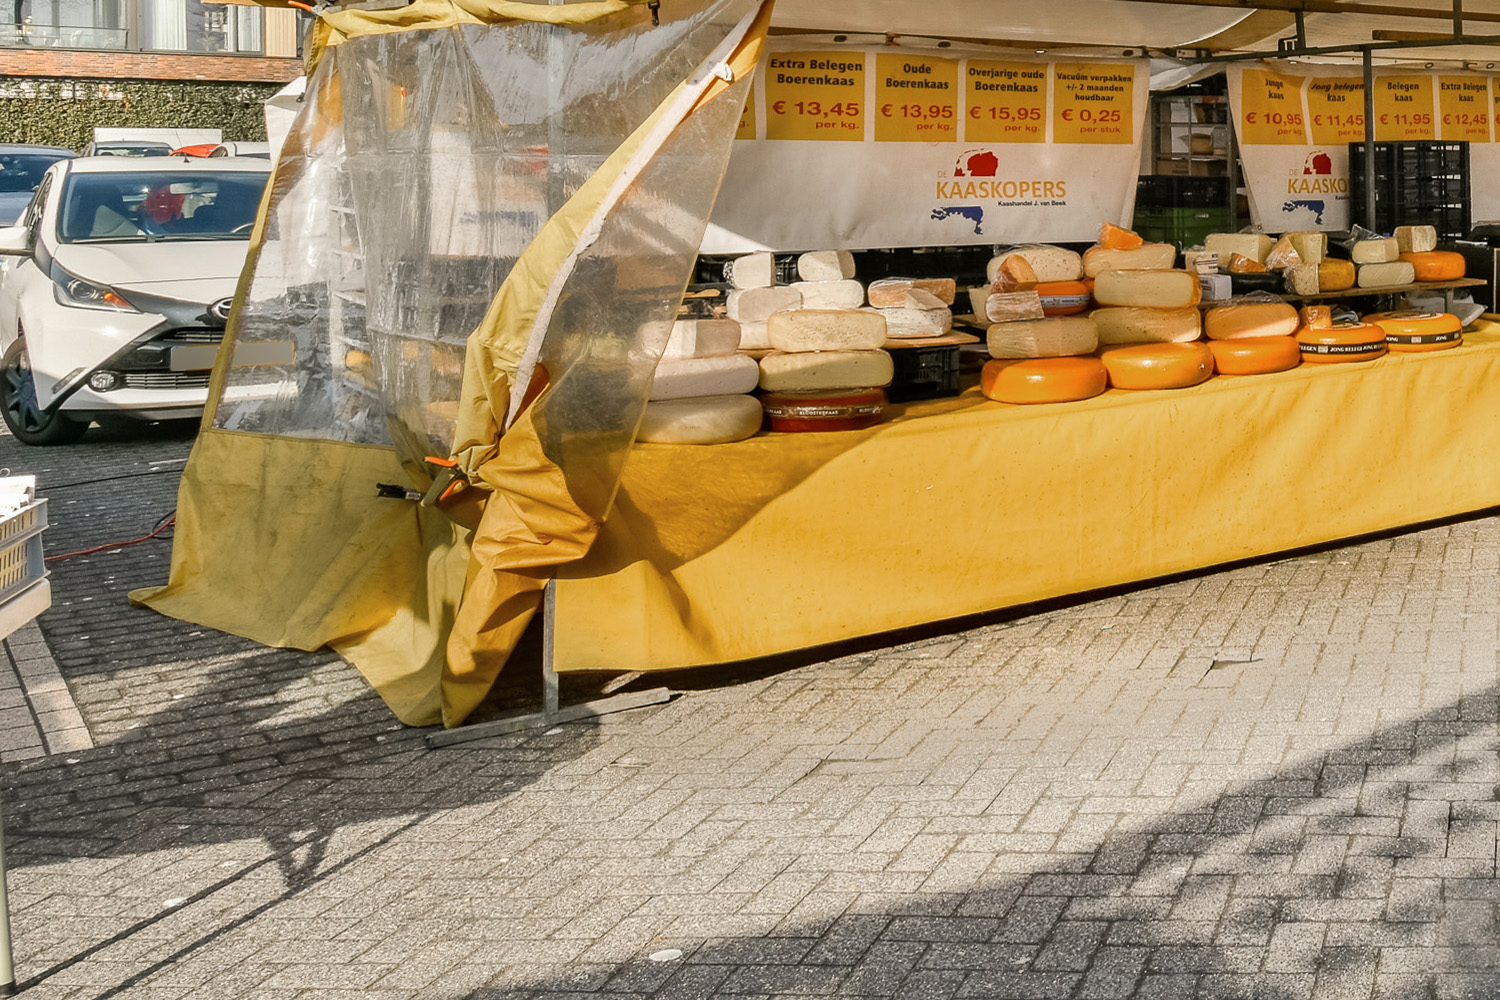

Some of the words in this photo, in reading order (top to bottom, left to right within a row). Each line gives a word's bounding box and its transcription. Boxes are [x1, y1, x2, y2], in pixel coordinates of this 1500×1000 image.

[770, 59, 805, 69] Extra
[810, 59, 862, 73] Belegen
[903, 63, 931, 74] Oude
[968, 67, 1018, 79] Overjarige
[1021, 69, 1044, 79] oude
[1057, 72, 1088, 81] Vacuüm
[1090, 74, 1132, 83] verpakken
[777, 73, 855, 86] Boerenkaas
[886, 78, 949, 89] Boerenkaas
[1265, 78, 1284, 90] Jonge
[975, 81, 1038, 92] Boerenkaas
[1087, 84, 1124, 92] maanden
[1311, 83, 1332, 91] Jong
[1333, 83, 1364, 92] belegen
[1387, 82, 1419, 92] Belegen
[1441, 82, 1461, 91] Extra
[1463, 83, 1487, 92] Belegen
[1075, 94, 1114, 102] houdbaar
[1268, 90, 1284, 100] kaas
[1327, 93, 1345, 102] kaas
[1395, 94, 1413, 102] kaas
[1459, 94, 1474, 102] kaas
[772, 100, 786, 115] €
[794, 101, 859, 118] 13,45
[881, 104, 893, 117] €
[900, 104, 953, 120] 13,95
[969, 106, 981, 119] €
[989, 107, 1041, 122] 15,95
[1061, 108, 1073, 121] €
[1080, 109, 1121, 123] 0,25
[1246, 112, 1257, 124] €
[1263, 113, 1302, 126] 10,95
[1314, 115, 1322, 126] €
[1327, 115, 1364, 127] 11,45
[1380, 114, 1389, 125] €
[1393, 114, 1431, 127] 11,95
[1443, 114, 1451, 125] €
[1455, 114, 1487, 127] 12,45
[815, 121, 837, 129] per
[840, 120, 859, 130] kg.
[937, 123, 953, 131] kg.
[1025, 124, 1040, 133] kg.
[1419, 127, 1431, 135] kg.
[938, 170, 947, 178] DE
[936, 181, 1066, 199] KAASKOPERS
[1287, 178, 1349, 194] KAASKO
